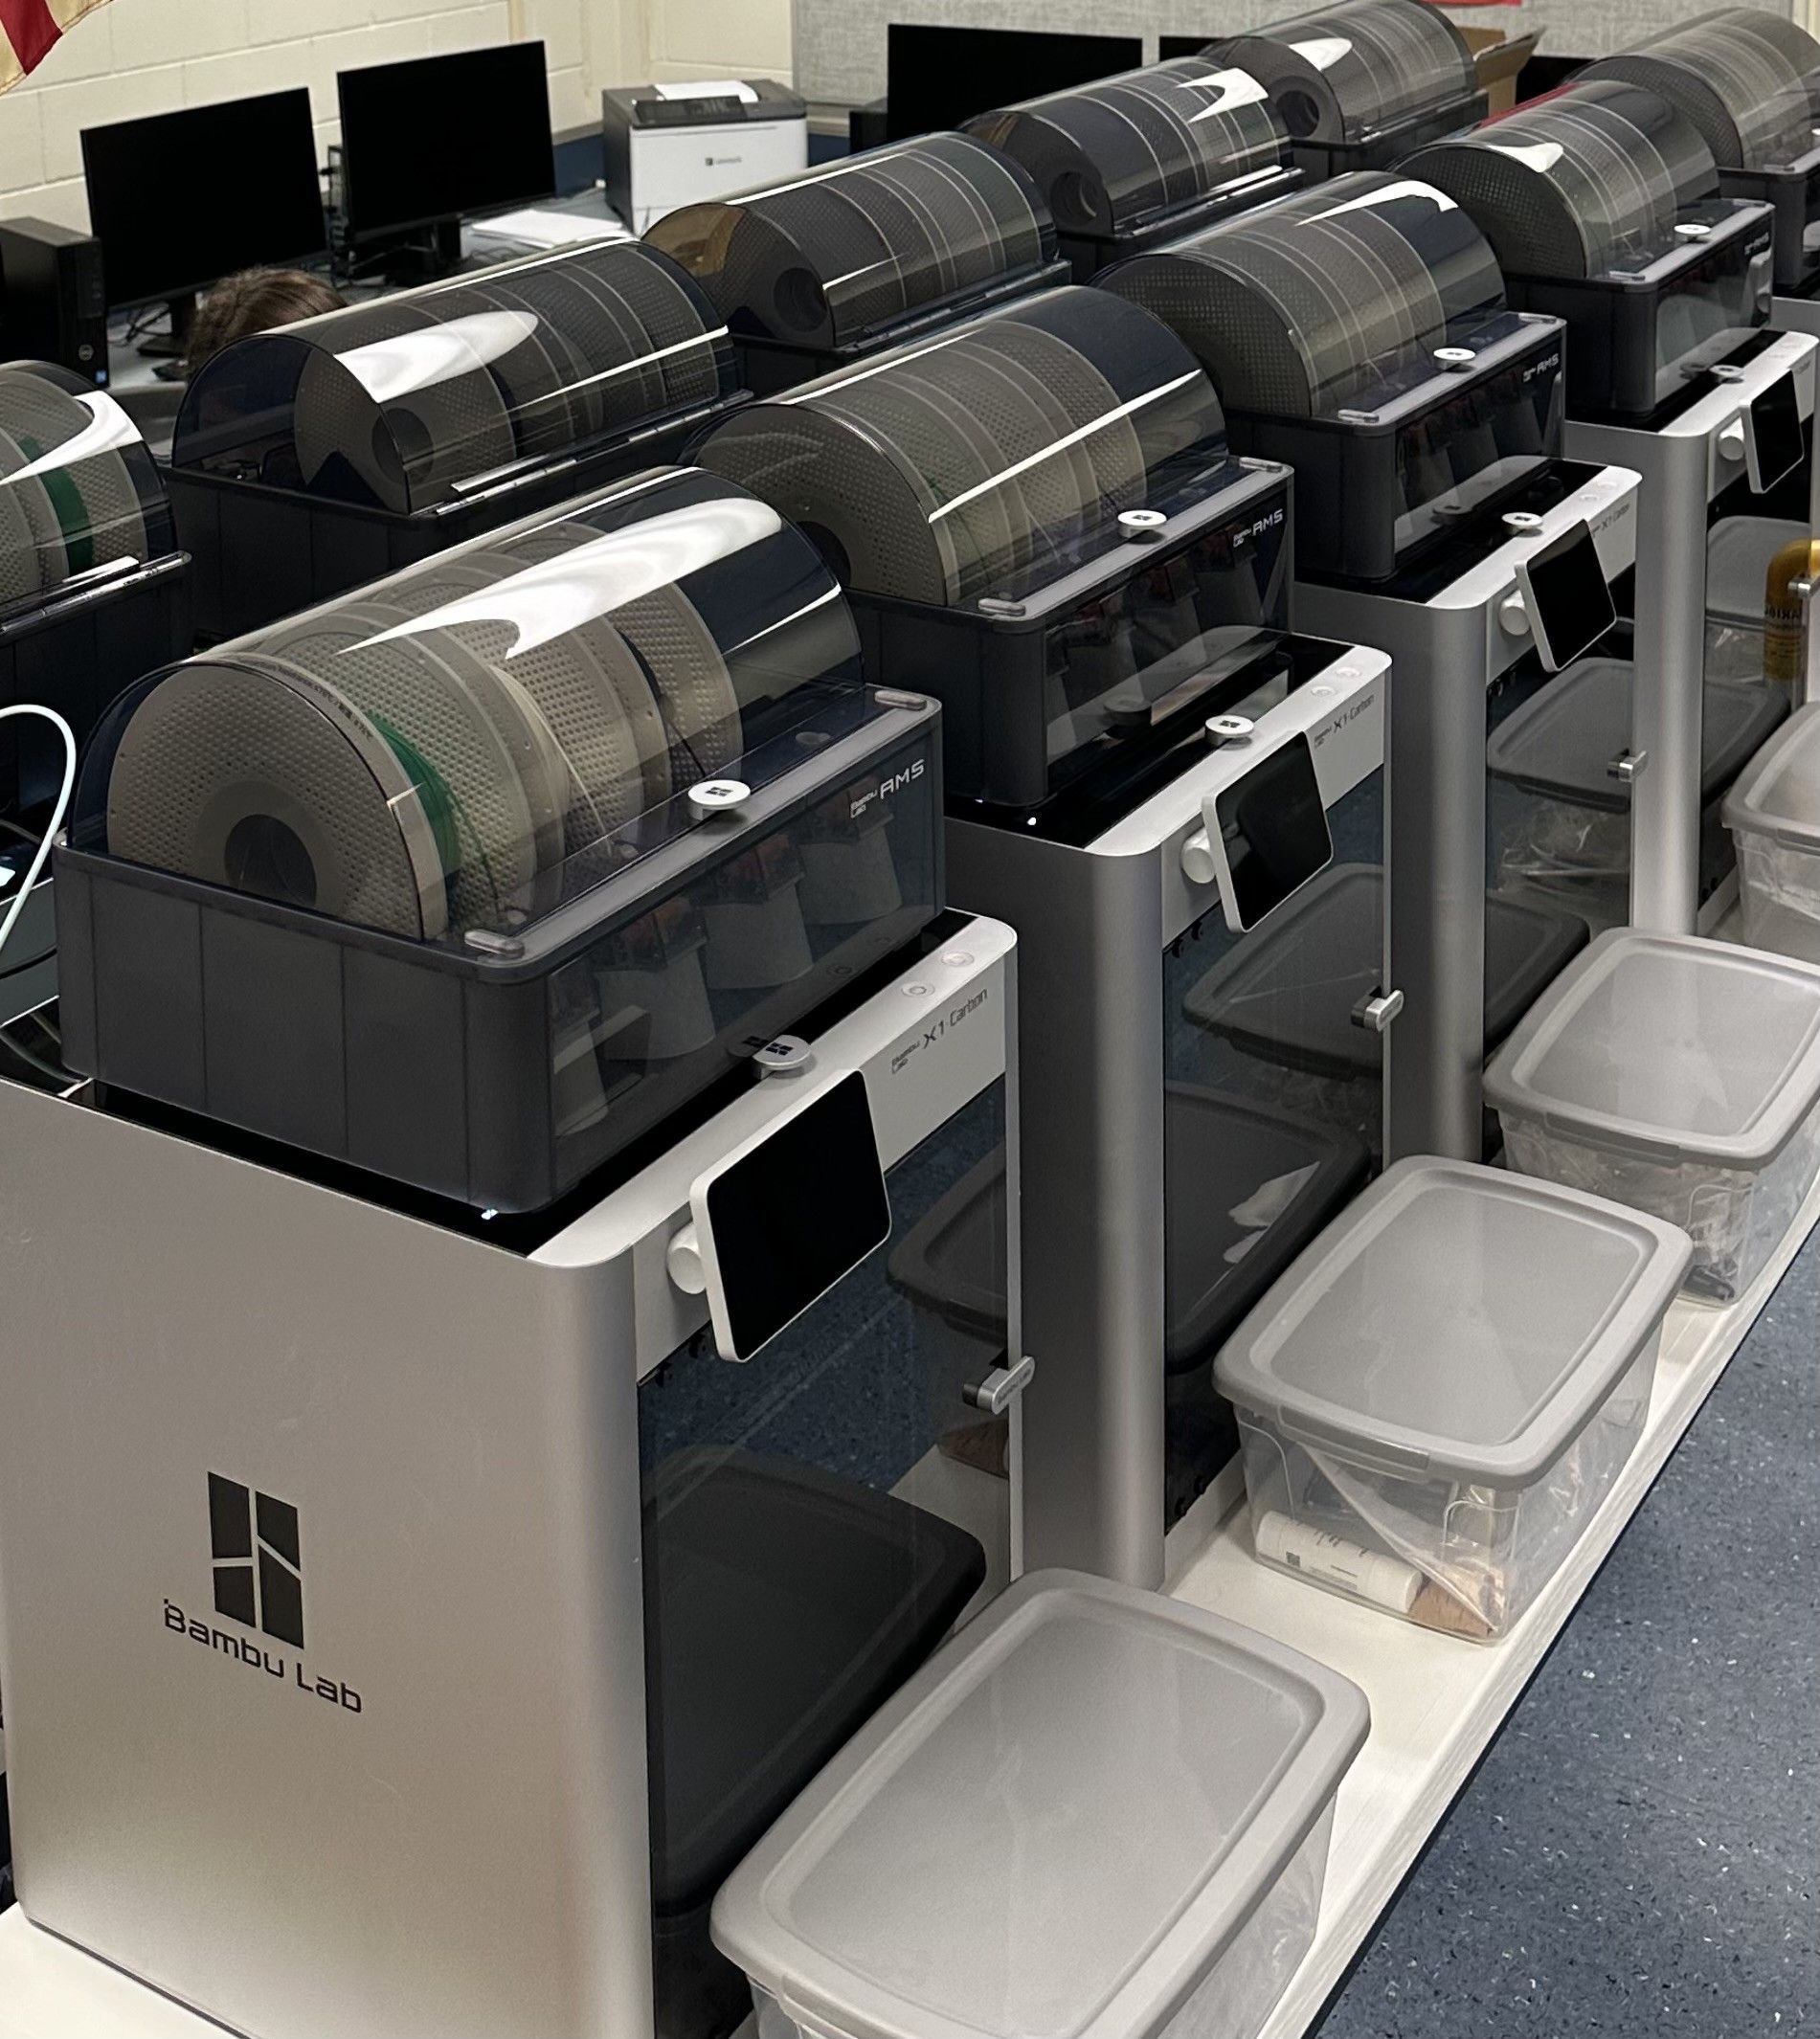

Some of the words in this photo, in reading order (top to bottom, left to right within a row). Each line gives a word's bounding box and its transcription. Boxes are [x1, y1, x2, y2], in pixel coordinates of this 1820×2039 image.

[1252, 508, 1283, 536] AMS
[880, 758, 925, 799] AMS
[923, 1020, 944, 1049] X1
[950, 989, 988, 1026] Carbon
[164, 1599, 284, 1678] Bambu
[297, 1662, 362, 1714] Lab
